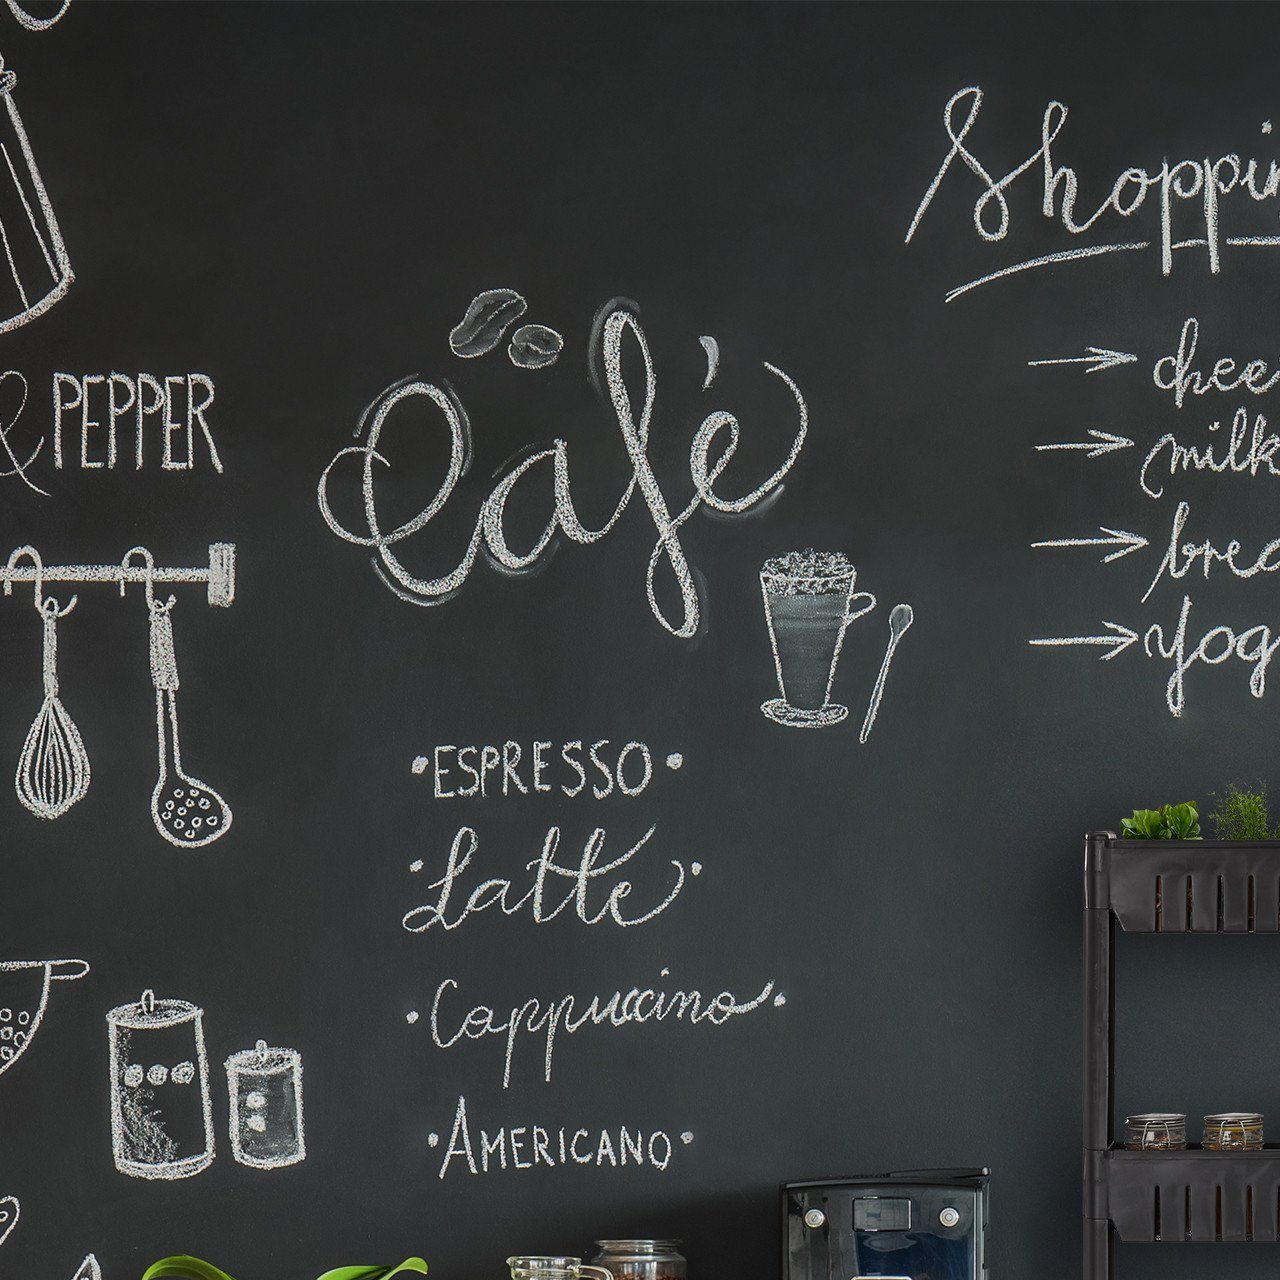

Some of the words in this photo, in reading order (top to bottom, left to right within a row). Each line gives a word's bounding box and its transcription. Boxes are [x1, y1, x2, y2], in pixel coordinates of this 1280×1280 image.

[53, 372, 223, 473] PEPPER
[434, 740, 652, 800] ESPRESSO
[402, 824, 685, 933] Latte
